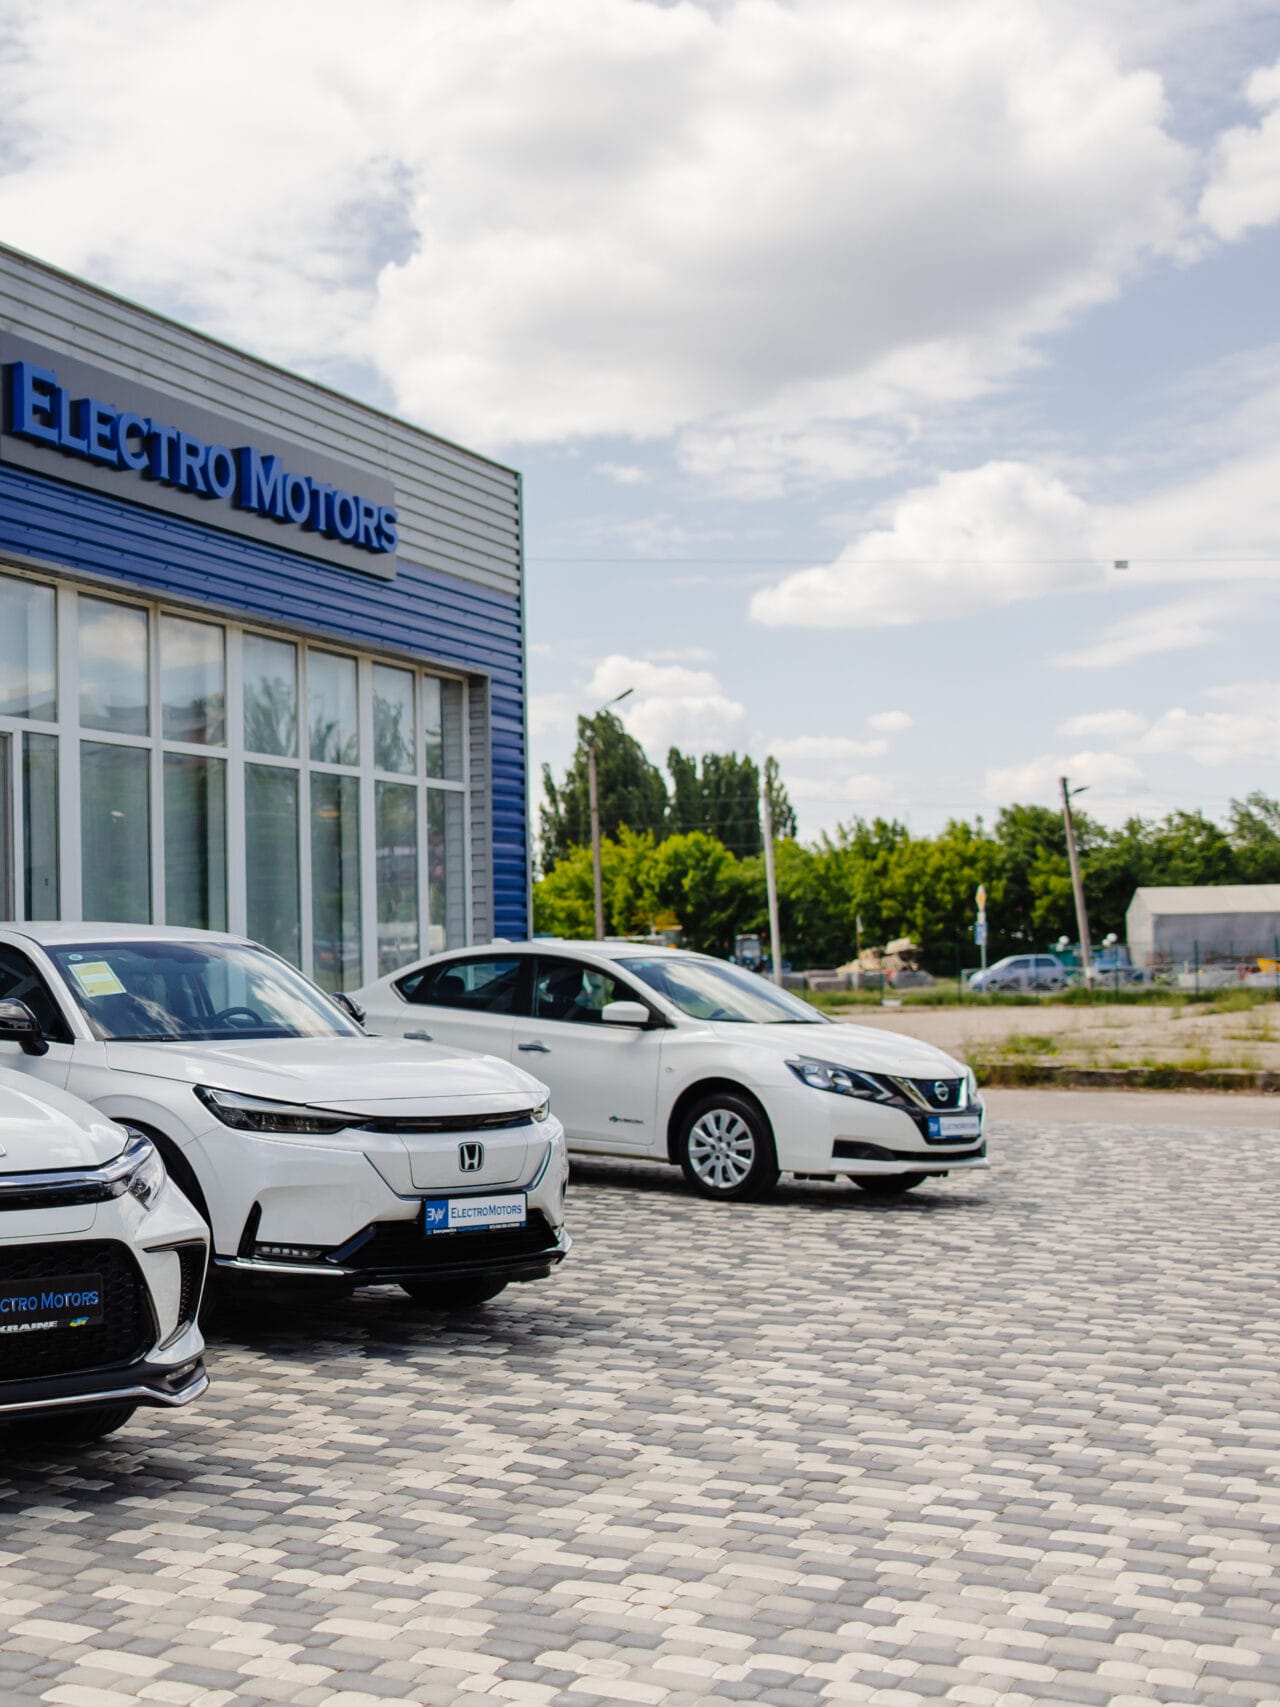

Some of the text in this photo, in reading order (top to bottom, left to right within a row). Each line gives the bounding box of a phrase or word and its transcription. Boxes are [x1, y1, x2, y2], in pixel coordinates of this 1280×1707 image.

[12, 361, 398, 553] ELECTRO MOTORS
[41, 1290, 99, 1310] MOTORS
